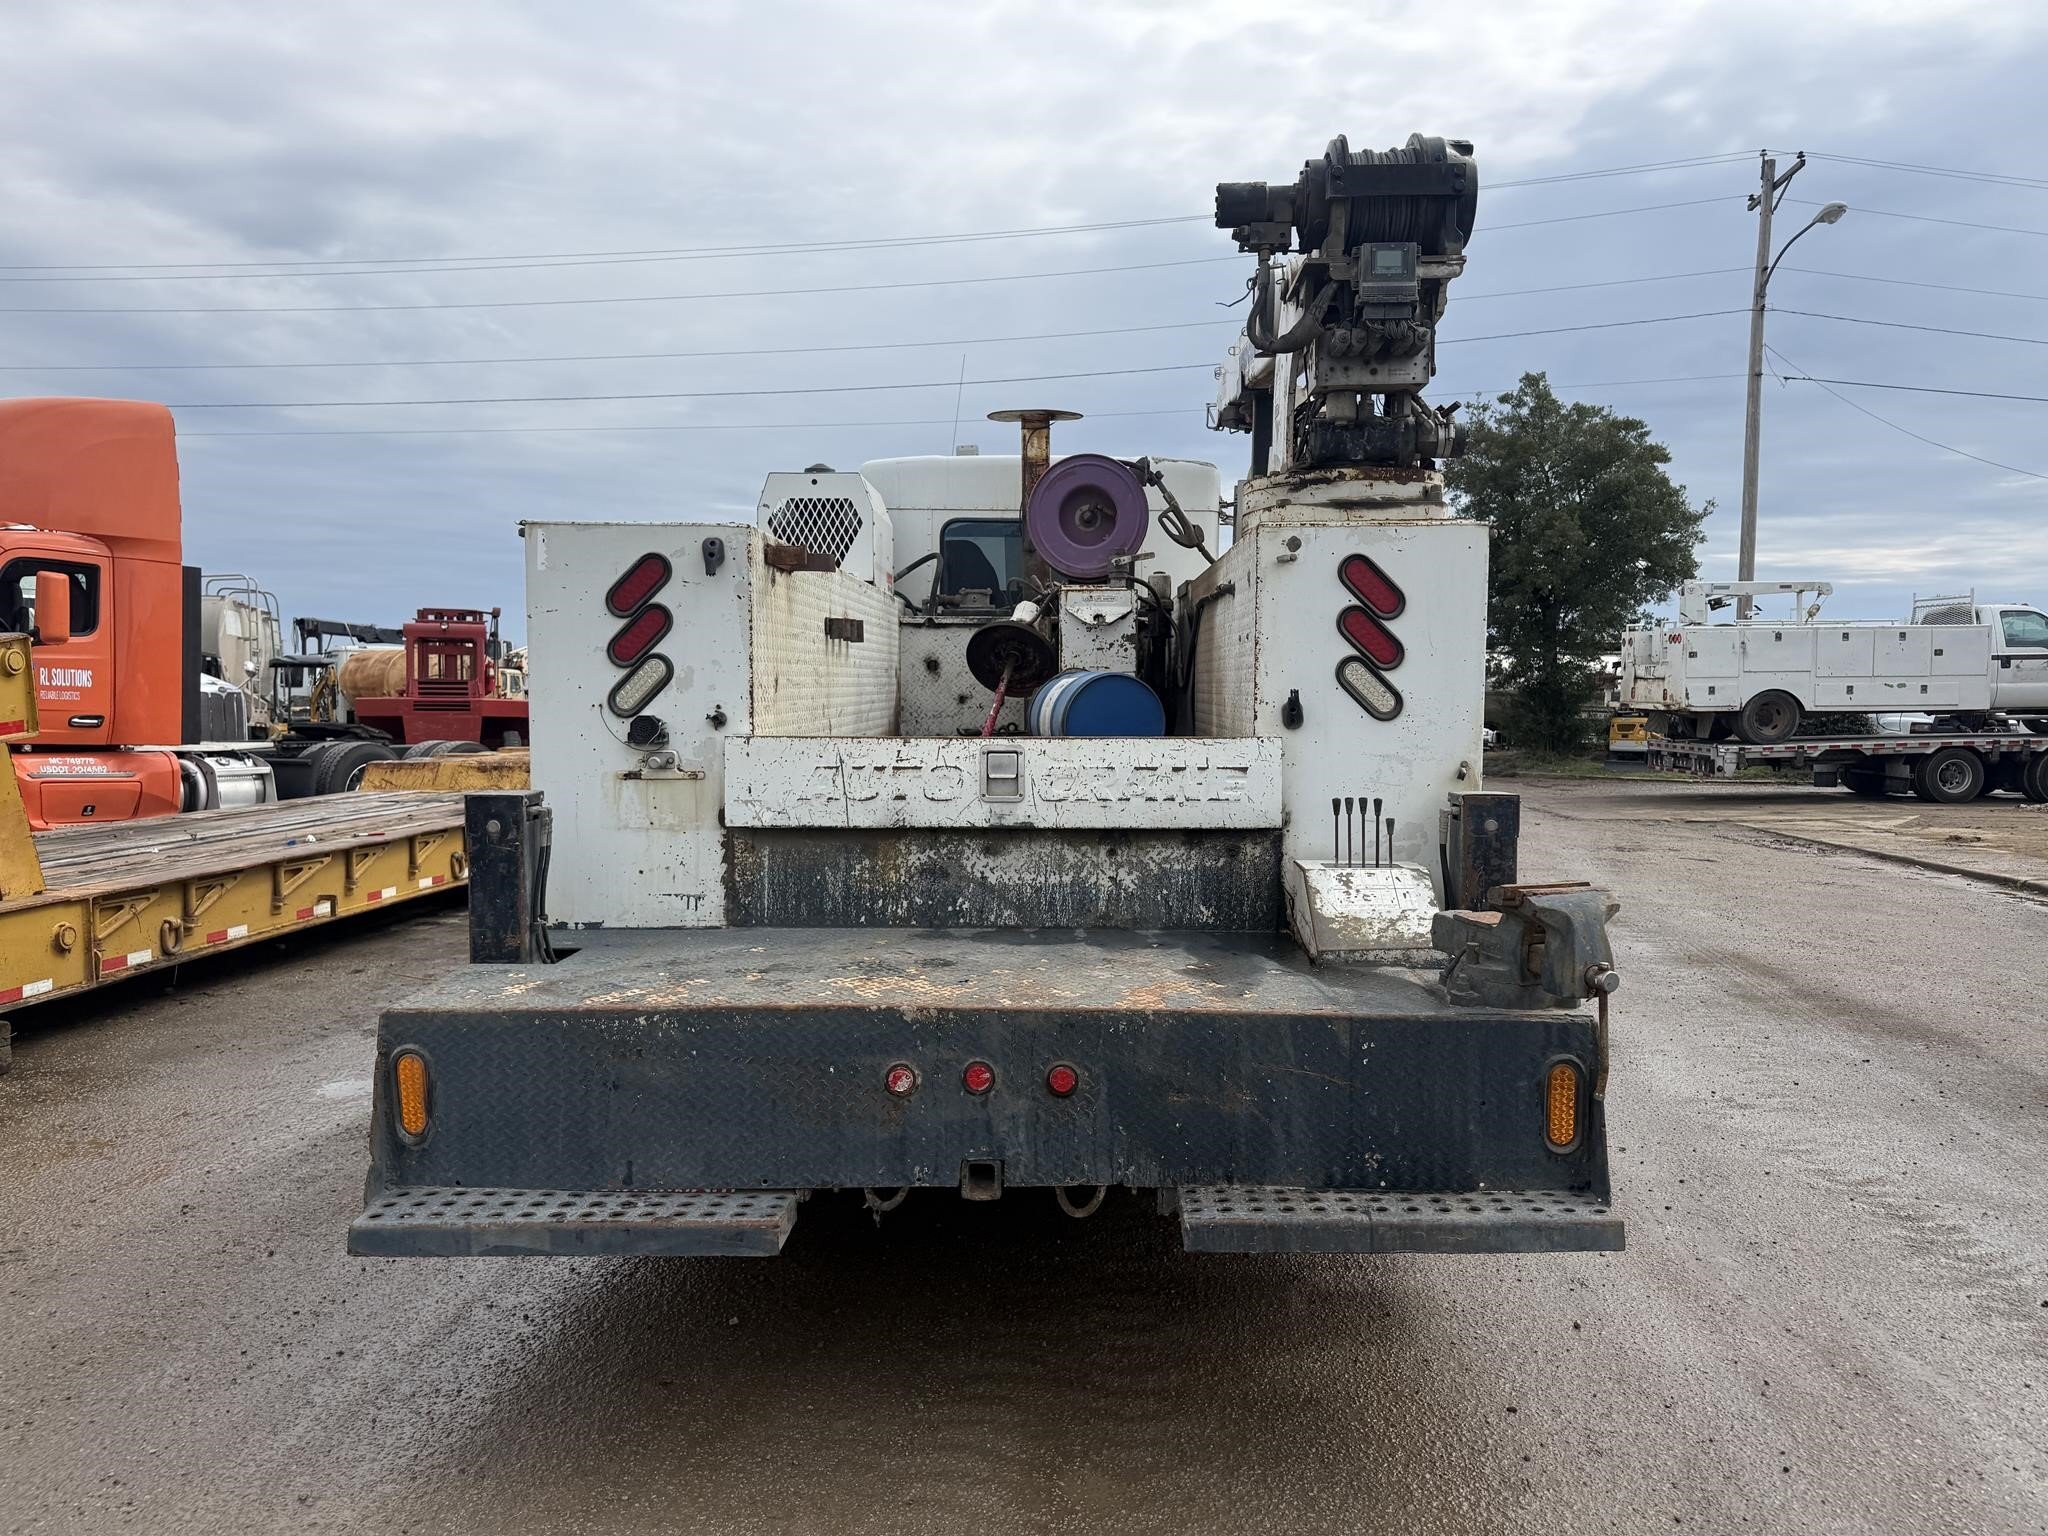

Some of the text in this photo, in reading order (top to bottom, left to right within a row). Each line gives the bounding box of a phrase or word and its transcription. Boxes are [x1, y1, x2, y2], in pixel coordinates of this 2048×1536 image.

[40, 667, 92, 688] RL SOLUTIONS
[59, 691, 80, 701] LOGISTICS
[40, 765, 69, 773] USDOT
[796, 765, 964, 801] AUTO
